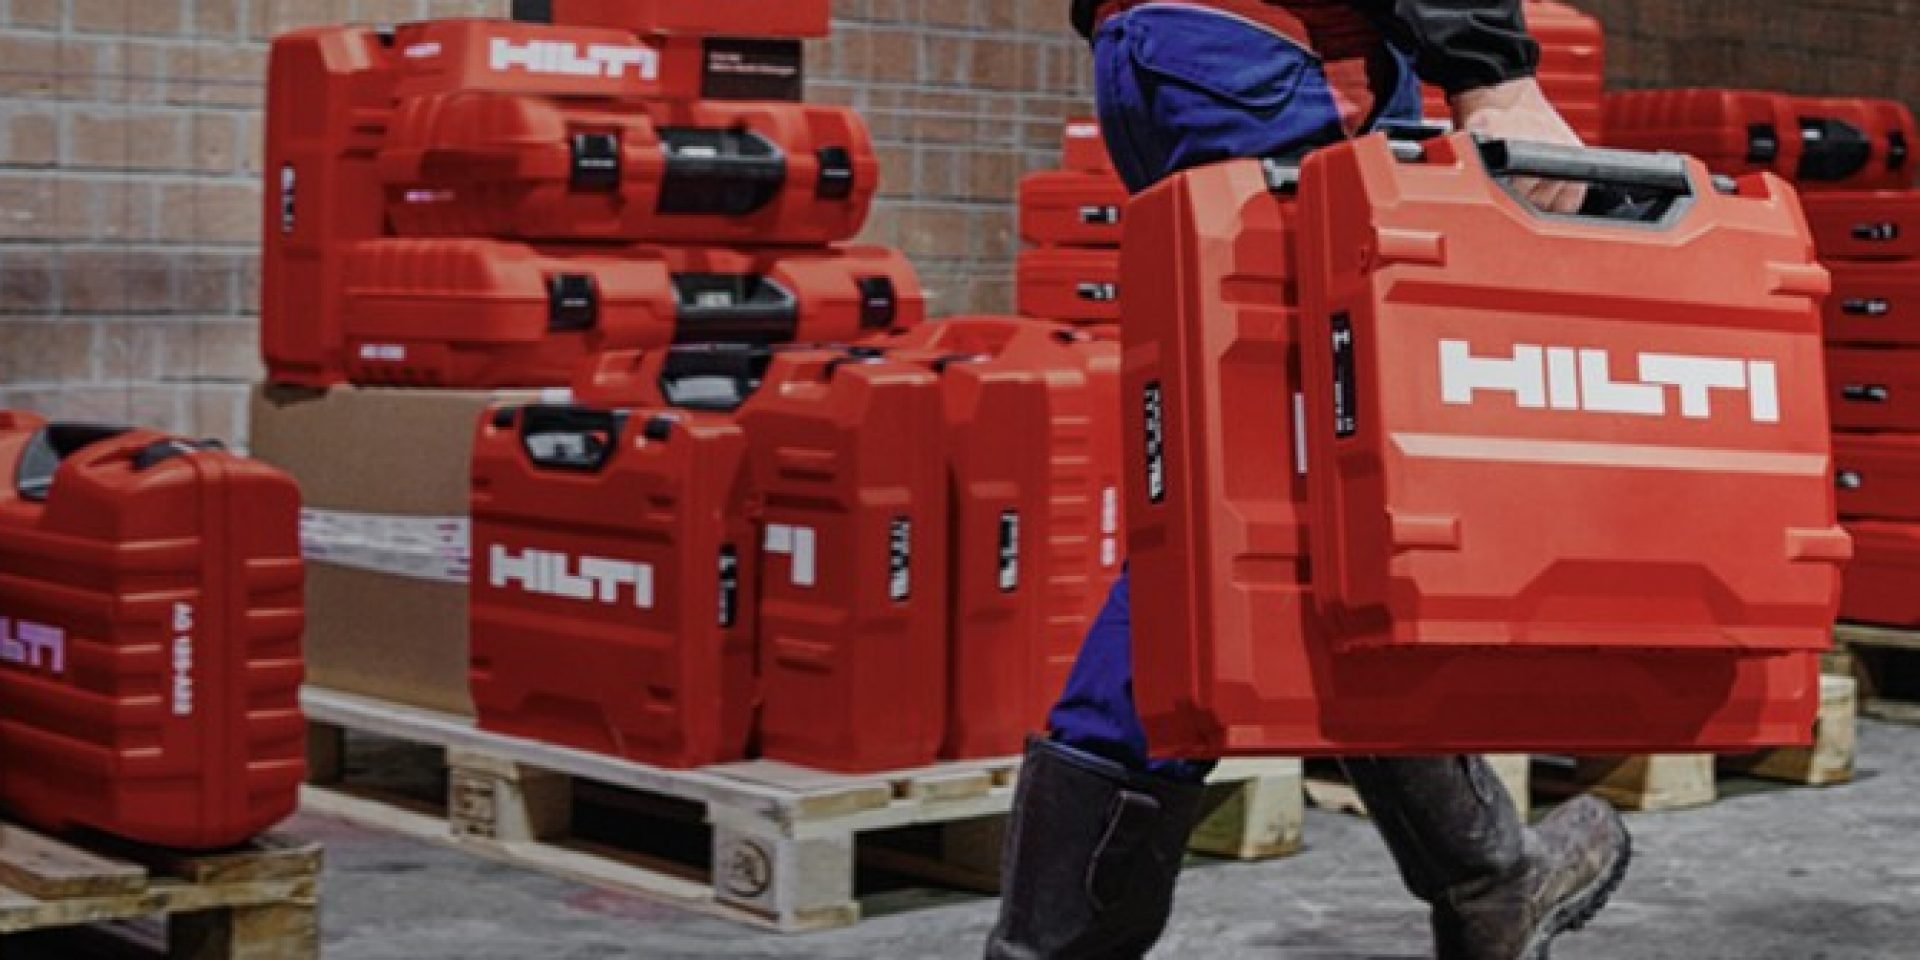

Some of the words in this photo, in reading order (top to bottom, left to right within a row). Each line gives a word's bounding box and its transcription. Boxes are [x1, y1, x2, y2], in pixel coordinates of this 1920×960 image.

[489, 38, 658, 80] HILTI
[1438, 338, 1780, 423] HILTI
[489, 543, 654, 608] HILTI
[0, 616, 65, 672] LTI
